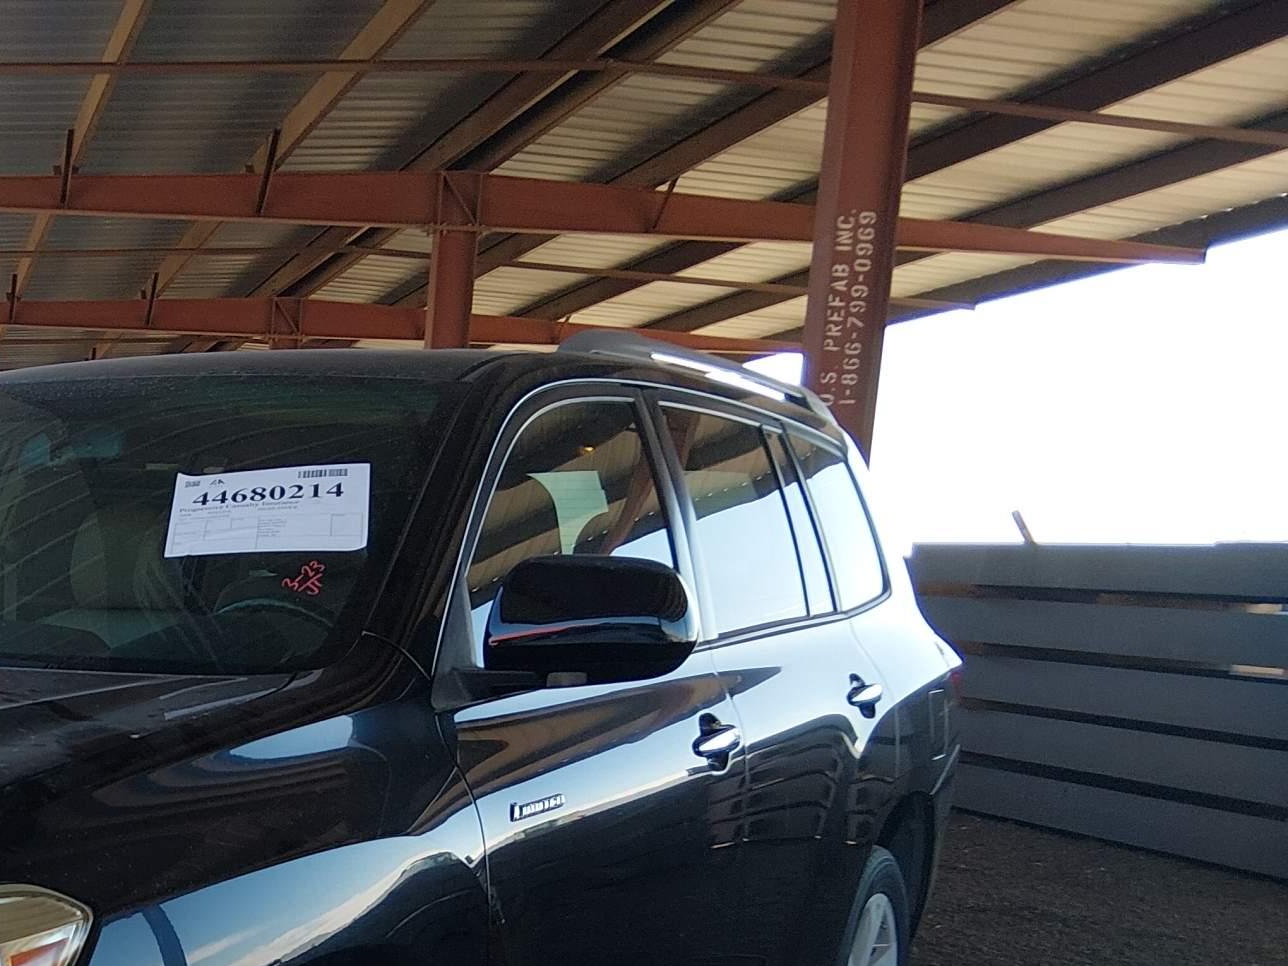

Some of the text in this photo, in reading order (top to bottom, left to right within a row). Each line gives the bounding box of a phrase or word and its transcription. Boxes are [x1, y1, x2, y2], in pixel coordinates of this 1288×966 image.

[835, 209, 856, 251] INC.
[822, 264, 850, 351] PREFAB
[838, 211, 877, 404] 1-866-799-0969
[192, 482, 344, 506] 44680214
[281, 560, 325, 591] 3-23
